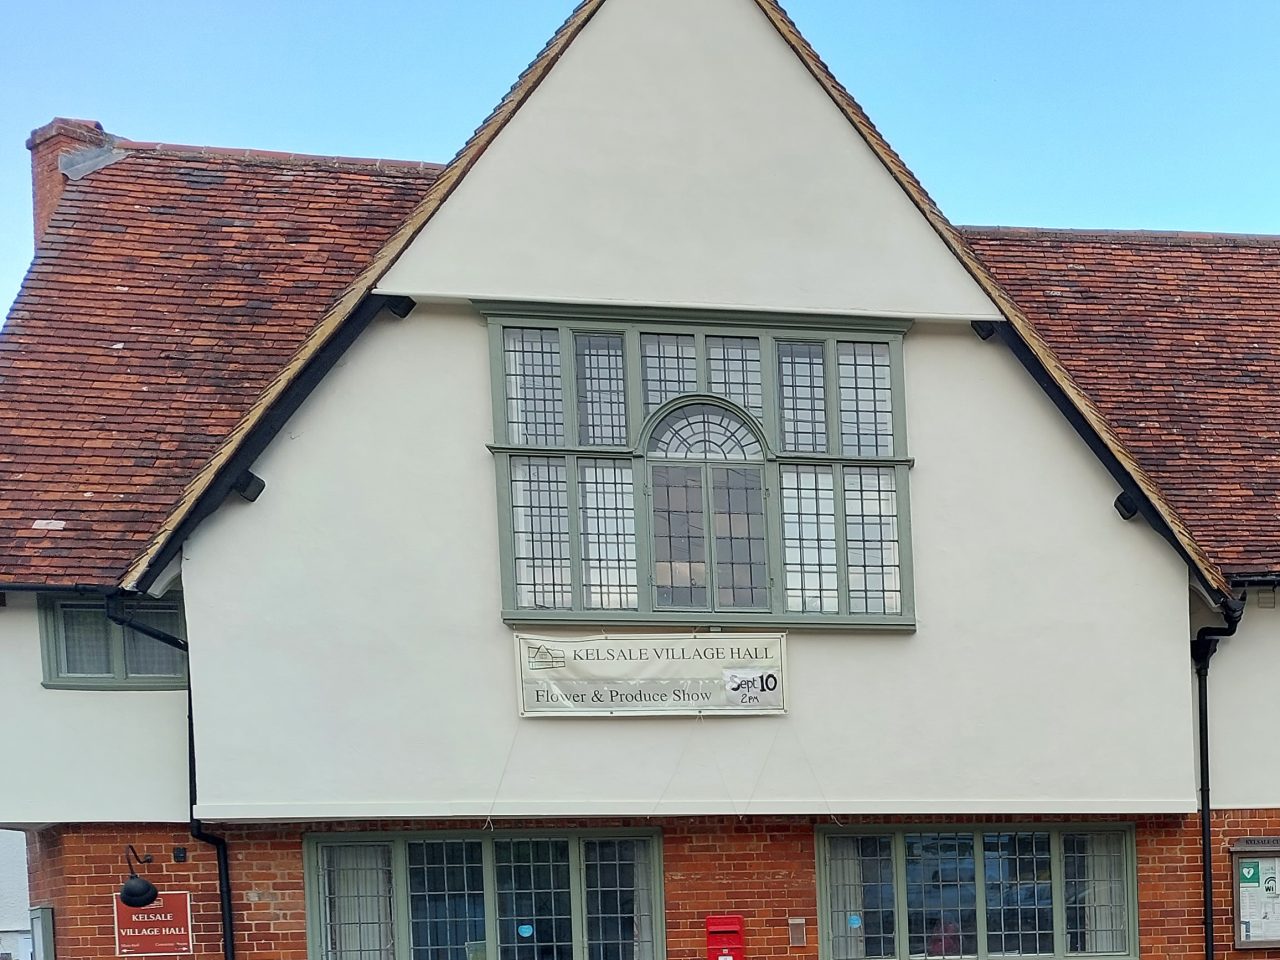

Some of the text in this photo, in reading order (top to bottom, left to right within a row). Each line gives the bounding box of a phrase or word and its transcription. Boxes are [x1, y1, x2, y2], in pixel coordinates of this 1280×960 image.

[573, 646, 774, 661] KELSALE VILLAGE HALL
[729, 673, 778, 693] Sept 10
[535, 689, 712, 703] Flower & Produce Show
[132, 913, 173, 921] KELSALE
[120, 927, 187, 936] VILLAGE HALL
